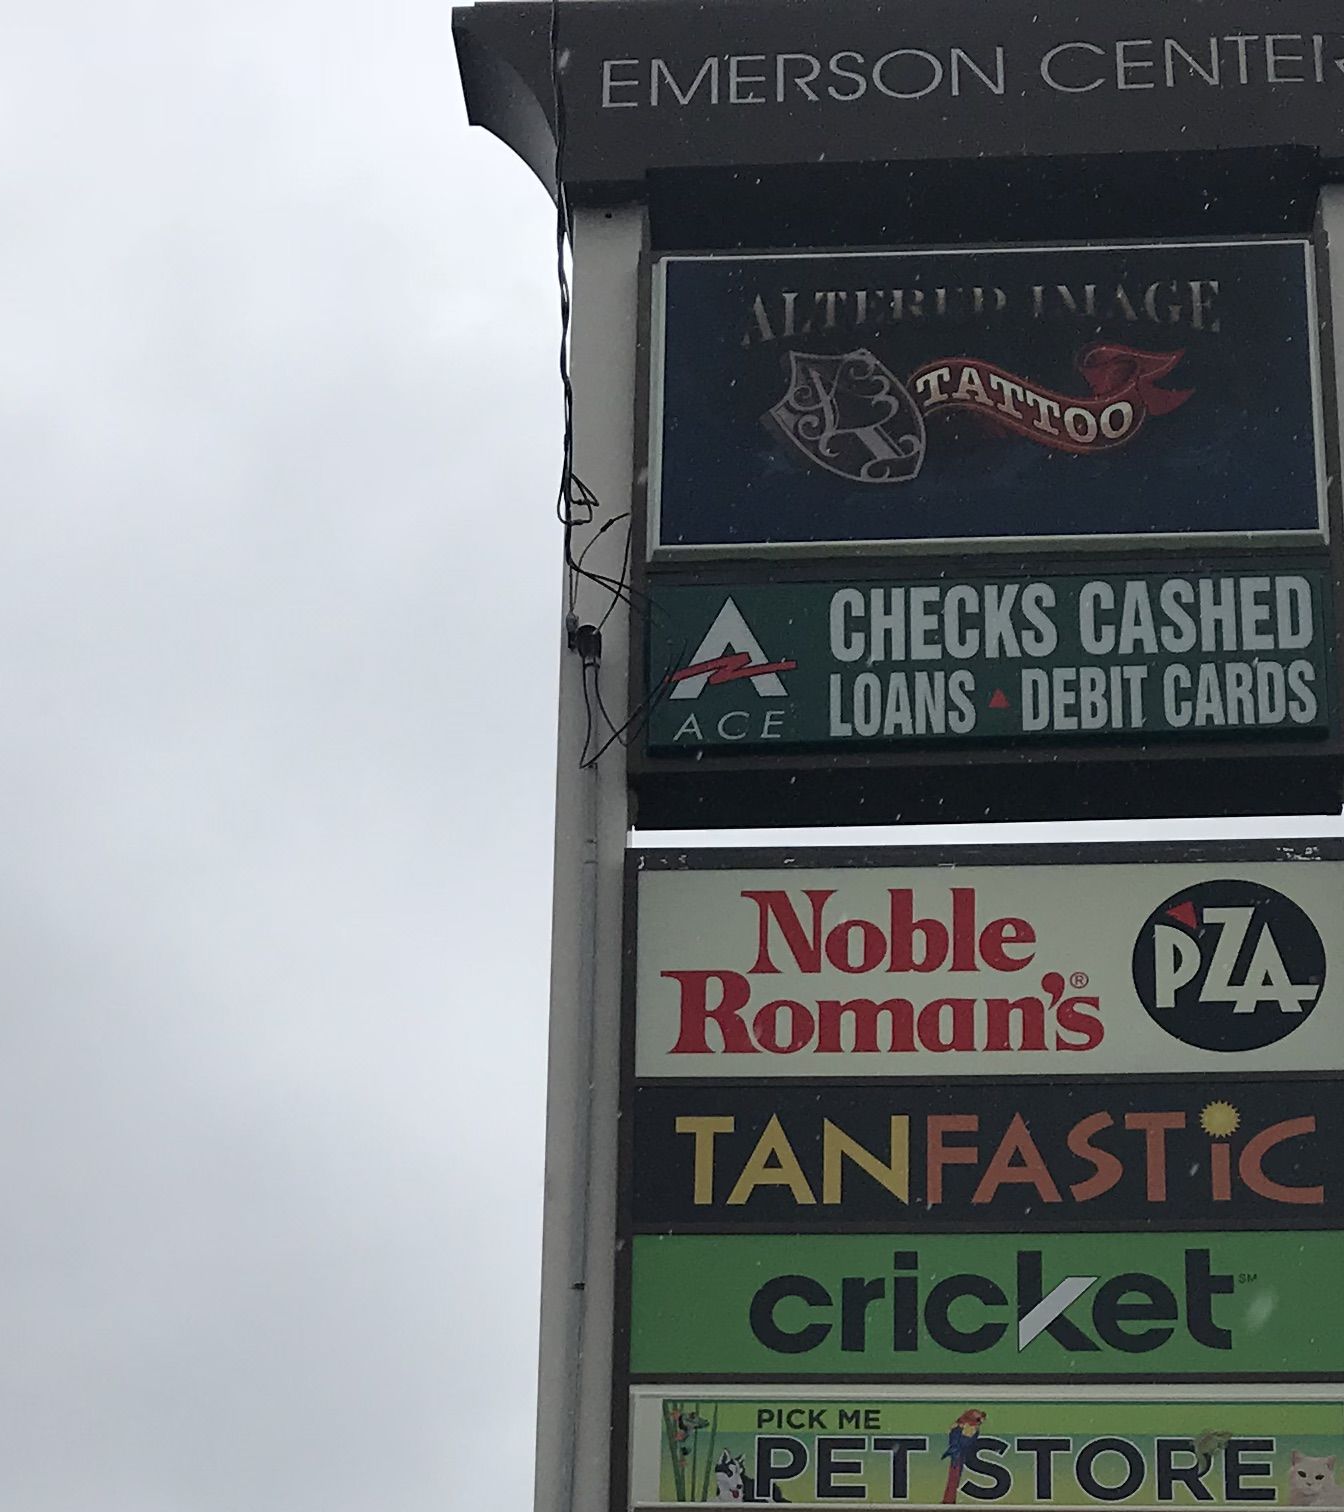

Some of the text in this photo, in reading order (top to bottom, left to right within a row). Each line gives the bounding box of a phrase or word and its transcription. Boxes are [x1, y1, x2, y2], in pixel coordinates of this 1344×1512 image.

[601, 46, 1004, 109] EMERSON
[1032, 279, 1222, 333] IMAGE
[915, 365, 1135, 443] TATTOO
[828, 575, 1314, 662] CHECKS CASHED
[671, 709, 787, 741] ACE
[828, 660, 1319, 738] LOANS DEBIT CARDS
[740, 887, 1037, 974] Noble
[660, 969, 1106, 1055] Roman's
[748, 1249, 1235, 1354] cricket
[756, 1408, 882, 1431] PICK ME
[755, 1433, 1279, 1502] PET STORE
